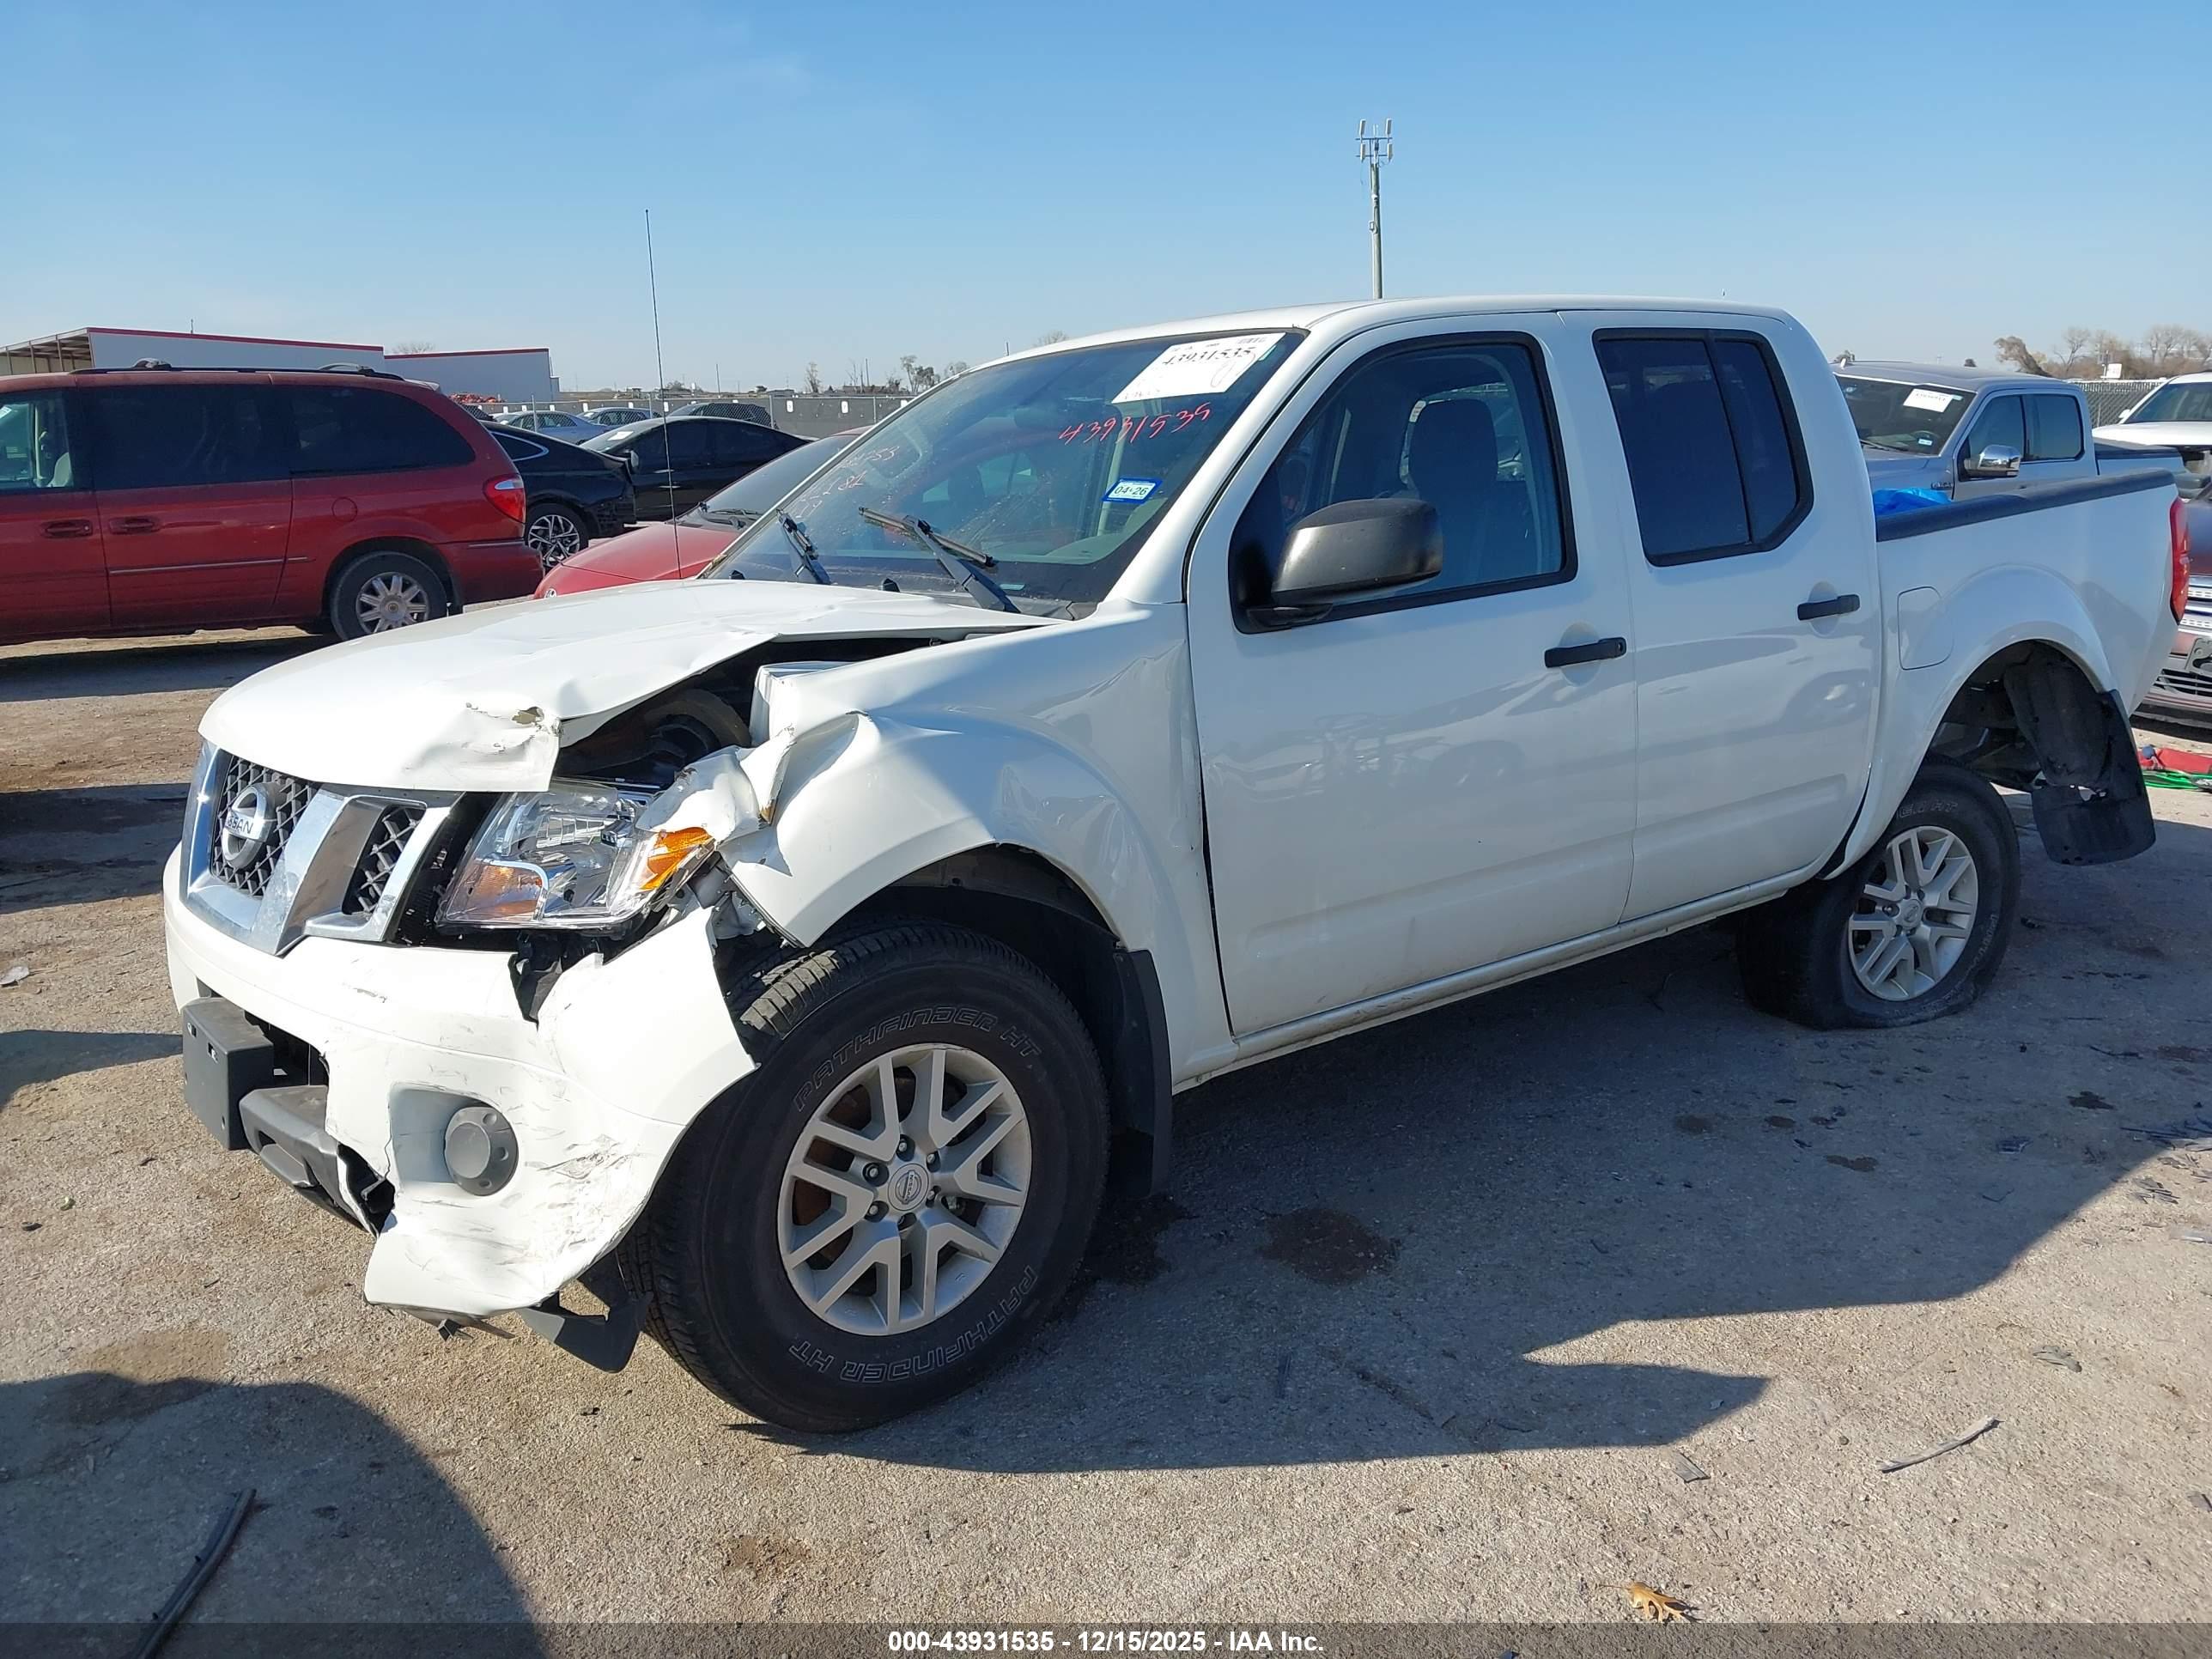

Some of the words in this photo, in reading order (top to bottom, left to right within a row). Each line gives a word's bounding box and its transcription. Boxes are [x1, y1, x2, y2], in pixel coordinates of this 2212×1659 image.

[1058, 402, 1212, 446] 43931535
[793, 1006, 999, 1112] PATHFINDER
[1000, 1024, 1044, 1059] HT
[787, 1340, 836, 1374] HT
[839, 1265, 1039, 1383] PATHFINDER
